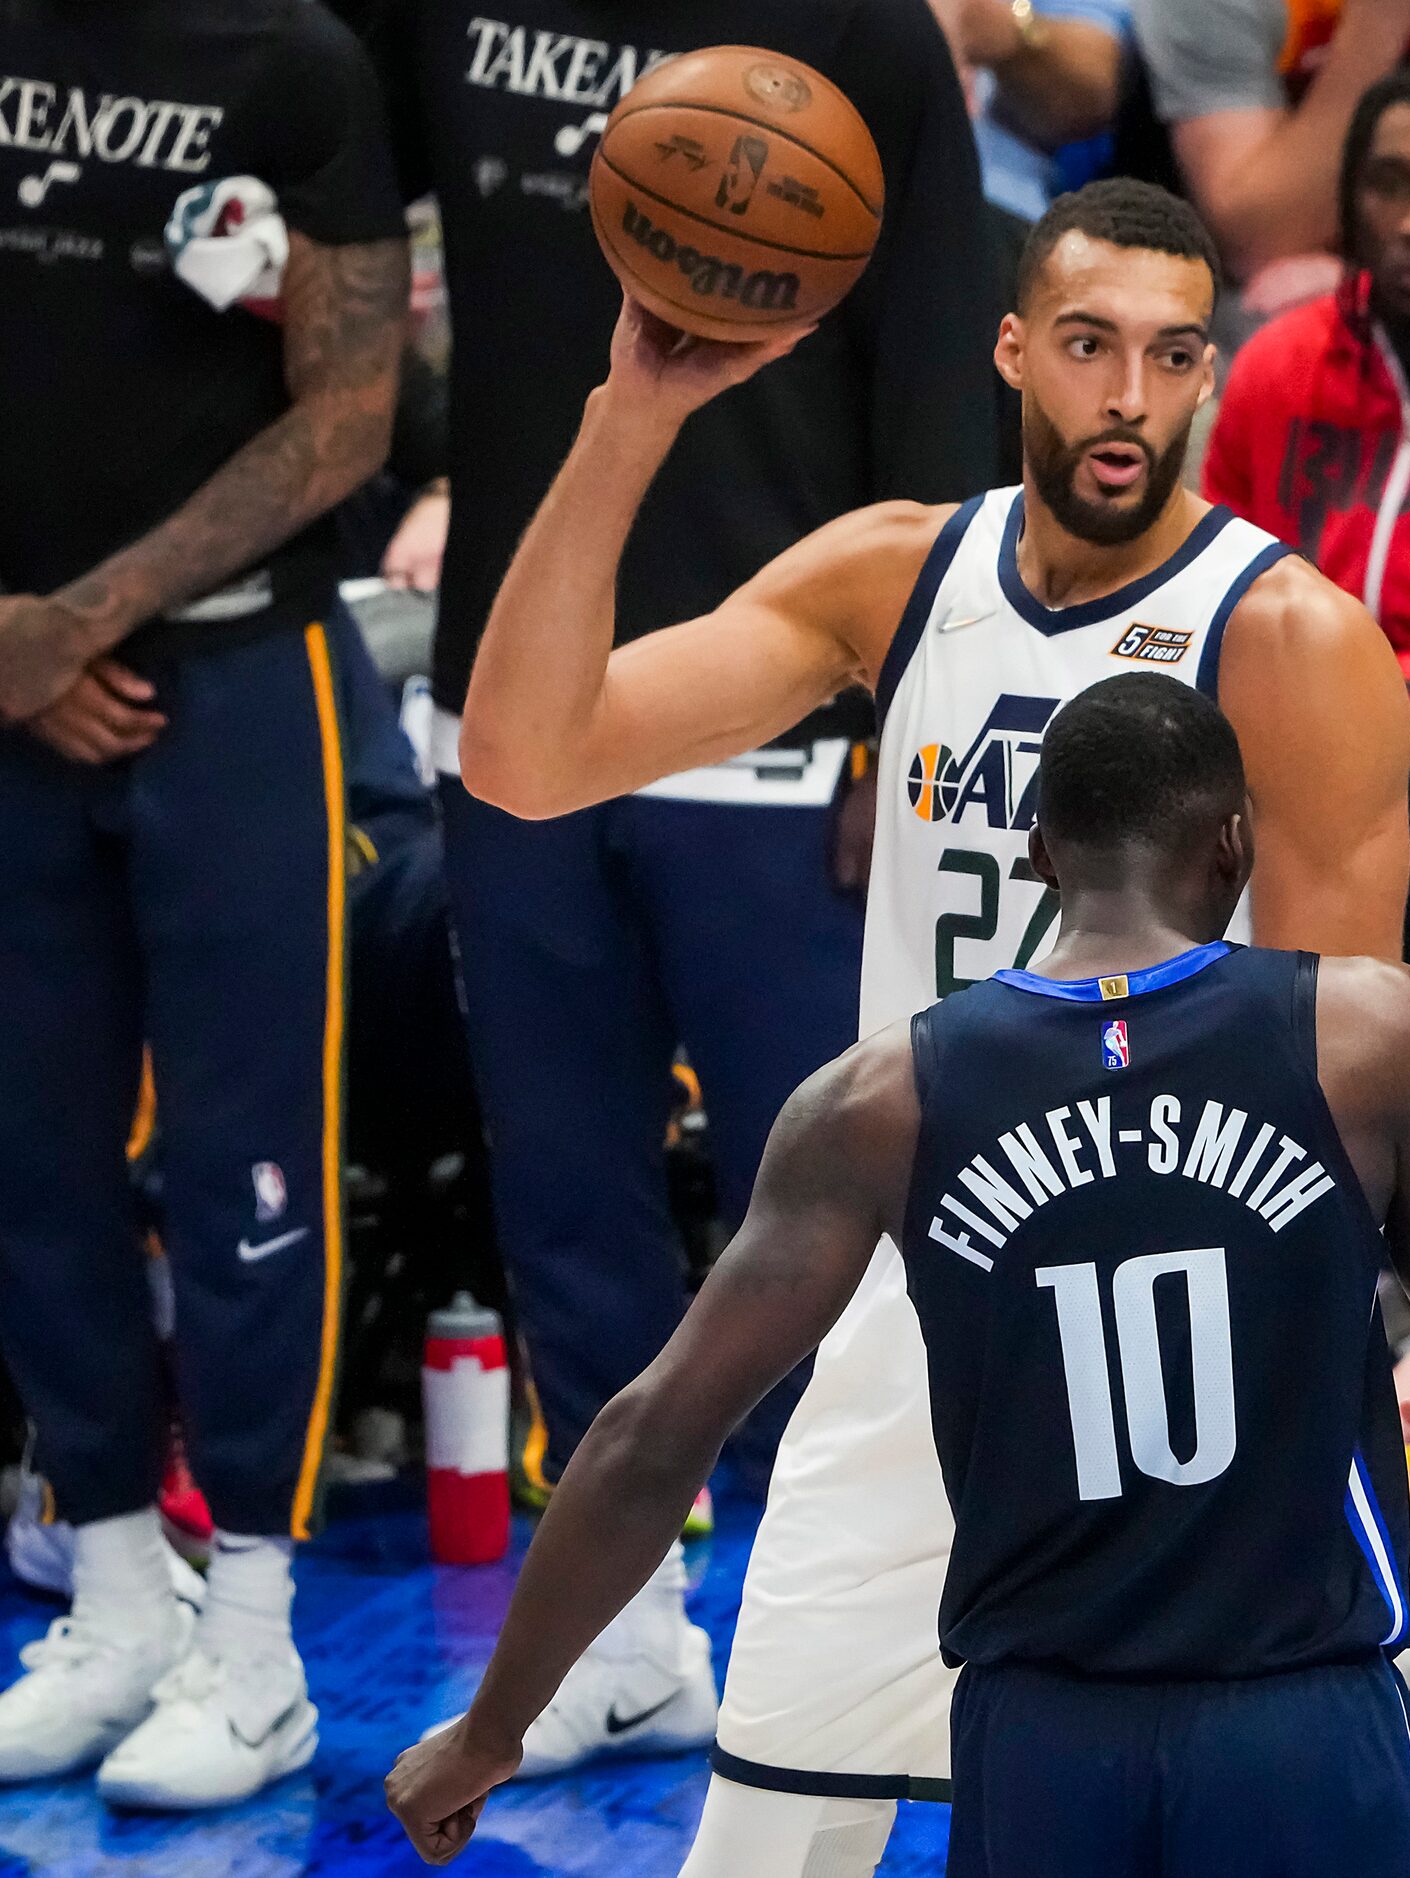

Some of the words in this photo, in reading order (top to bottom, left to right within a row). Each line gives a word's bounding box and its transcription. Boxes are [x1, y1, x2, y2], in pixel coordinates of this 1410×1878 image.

[1118, 626, 1149, 656] 5
[1139, 644, 1184, 661] FIGHT
[936, 848, 1061, 998] 27
[1107, 1055, 1118, 1067] 75
[928, 1095, 1335, 1272] FINNEY-SMITH
[1035, 1247, 1237, 1501] 10
